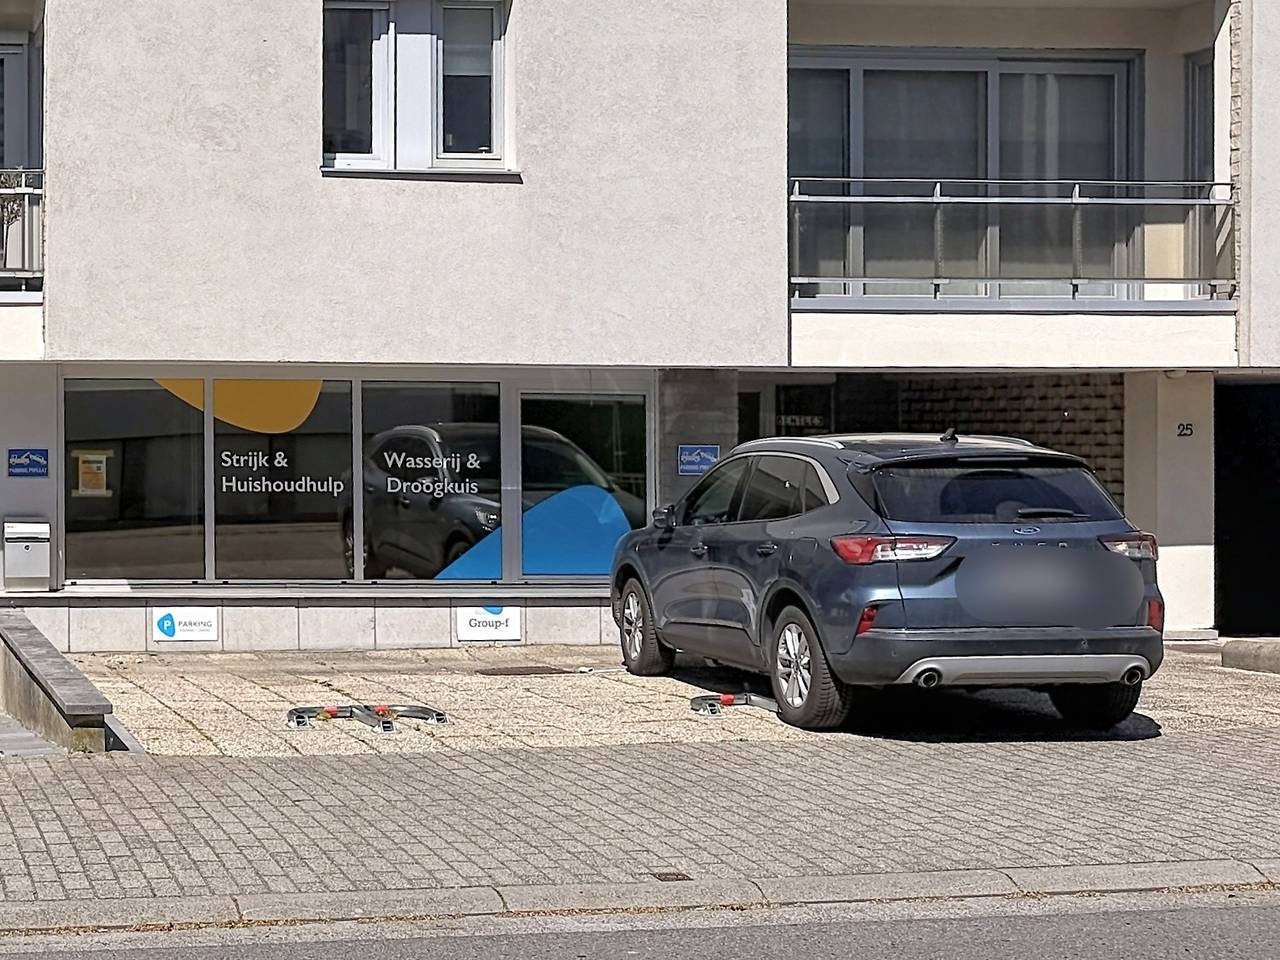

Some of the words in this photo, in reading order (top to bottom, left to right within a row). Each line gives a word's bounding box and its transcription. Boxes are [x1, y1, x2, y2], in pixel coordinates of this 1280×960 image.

[1177, 423, 1193, 437] 25
[220, 451, 269, 472] Strijk
[273, 451, 288, 468] &
[383, 451, 460, 473] Wasserij
[466, 453, 481, 469] &
[222, 476, 345, 497] Huishoudhulp
[386, 477, 479, 498] Droogkuis
[178, 620, 213, 628] PARKING
[468, 618, 510, 630] Group-f
